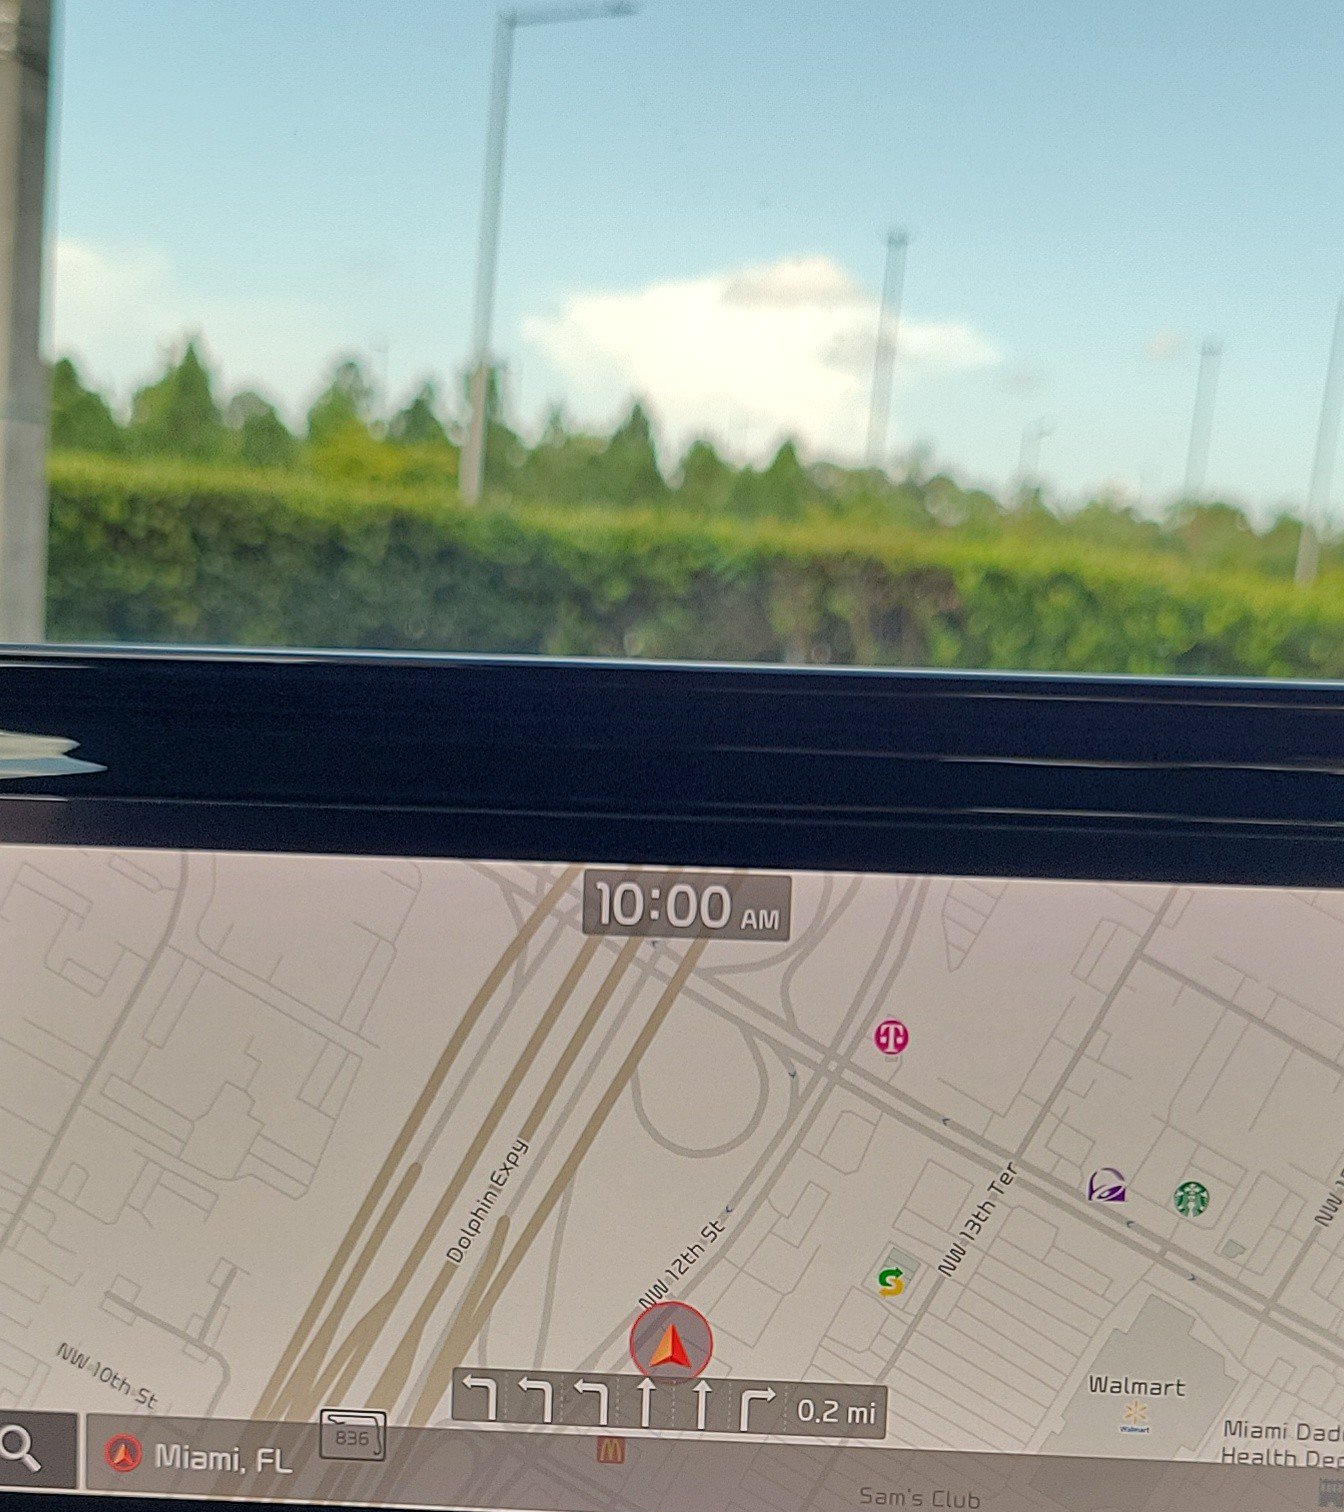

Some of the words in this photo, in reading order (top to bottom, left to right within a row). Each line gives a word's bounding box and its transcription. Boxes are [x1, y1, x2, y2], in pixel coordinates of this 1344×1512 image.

[596, 881, 731, 929] 10:00
[740, 909, 780, 930] AM
[446, 1190, 498, 1263] Dolphin
[490, 1139, 529, 1187] Expy
[1314, 1192, 1343, 1228] NW
[937, 1242, 967, 1278] NW
[958, 1200, 997, 1241] 13th
[987, 1161, 1018, 1195] Ter
[638, 1278, 670, 1310] NW
[664, 1244, 706, 1281] 12th
[700, 1220, 726, 1244] St
[56, 1341, 92, 1370] NW
[92, 1361, 131, 1396] 10th
[134, 1387, 159, 1410] St
[1088, 1374, 1186, 1397] Walmart
[797, 1398, 840, 1424] 0.2
[847, 1401, 876, 1425] mi
[335, 1430, 370, 1446] 836
[1224, 1419, 1288, 1440] Miami
[156, 1442, 247, 1475] Miami,
[256, 1447, 294, 1475] FL
[1221, 1447, 1297, 1467] Health
[859, 1486, 925, 1507] Sam's
[932, 1489, 981, 1509] Club
